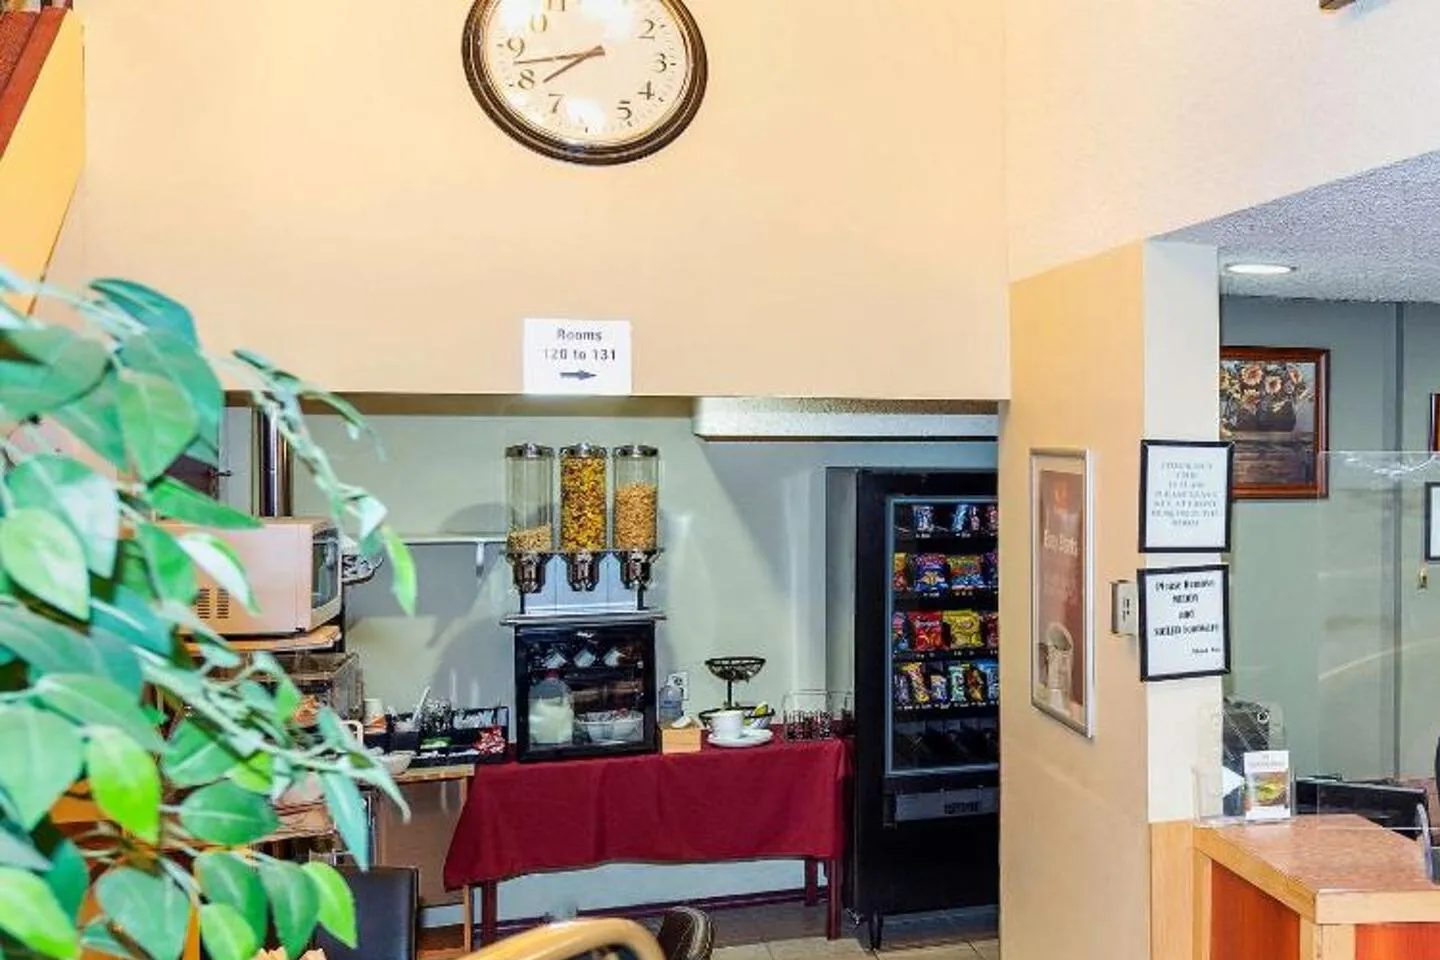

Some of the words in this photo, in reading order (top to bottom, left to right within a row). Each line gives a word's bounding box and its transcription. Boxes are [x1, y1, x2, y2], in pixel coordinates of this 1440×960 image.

[638, 18, 656, 40] 2
[507, 36, 526, 58] 9
[653, 53, 668, 73] 3
[517, 69, 536, 90] 8
[637, 80, 656, 101] 4
[548, 93, 564, 114] 7
[616, 101, 633, 121] 5
[557, 327, 603, 341] Rooms
[543, 348, 568, 360] 120
[573, 348, 587, 360] to
[592, 348, 616, 361] 131
